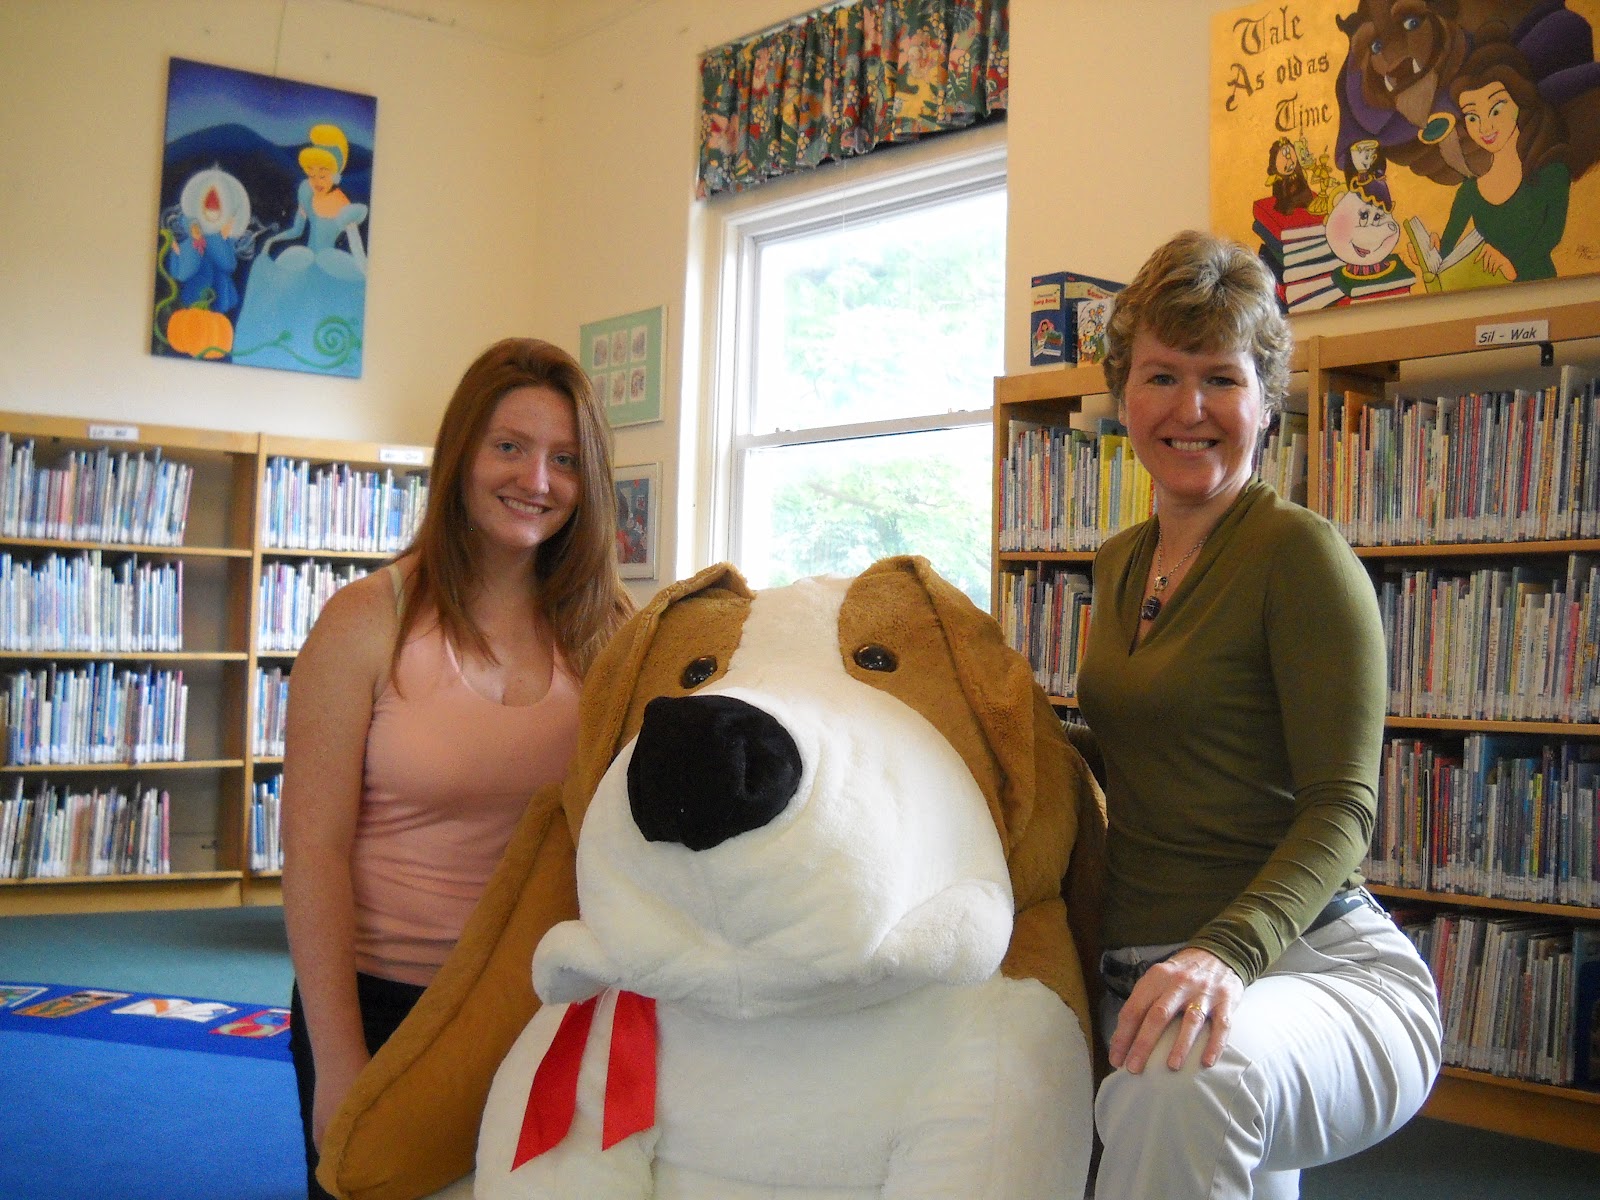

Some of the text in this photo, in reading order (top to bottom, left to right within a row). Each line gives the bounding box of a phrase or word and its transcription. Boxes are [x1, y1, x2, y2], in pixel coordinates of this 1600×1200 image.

[1233, 5, 1304, 55] Tale
[1225, 52, 1330, 112] As old as
[1274, 92, 1333, 137] Time
[1479, 330, 1495, 344] Sil
[1510, 326, 1537, 341] Wak
